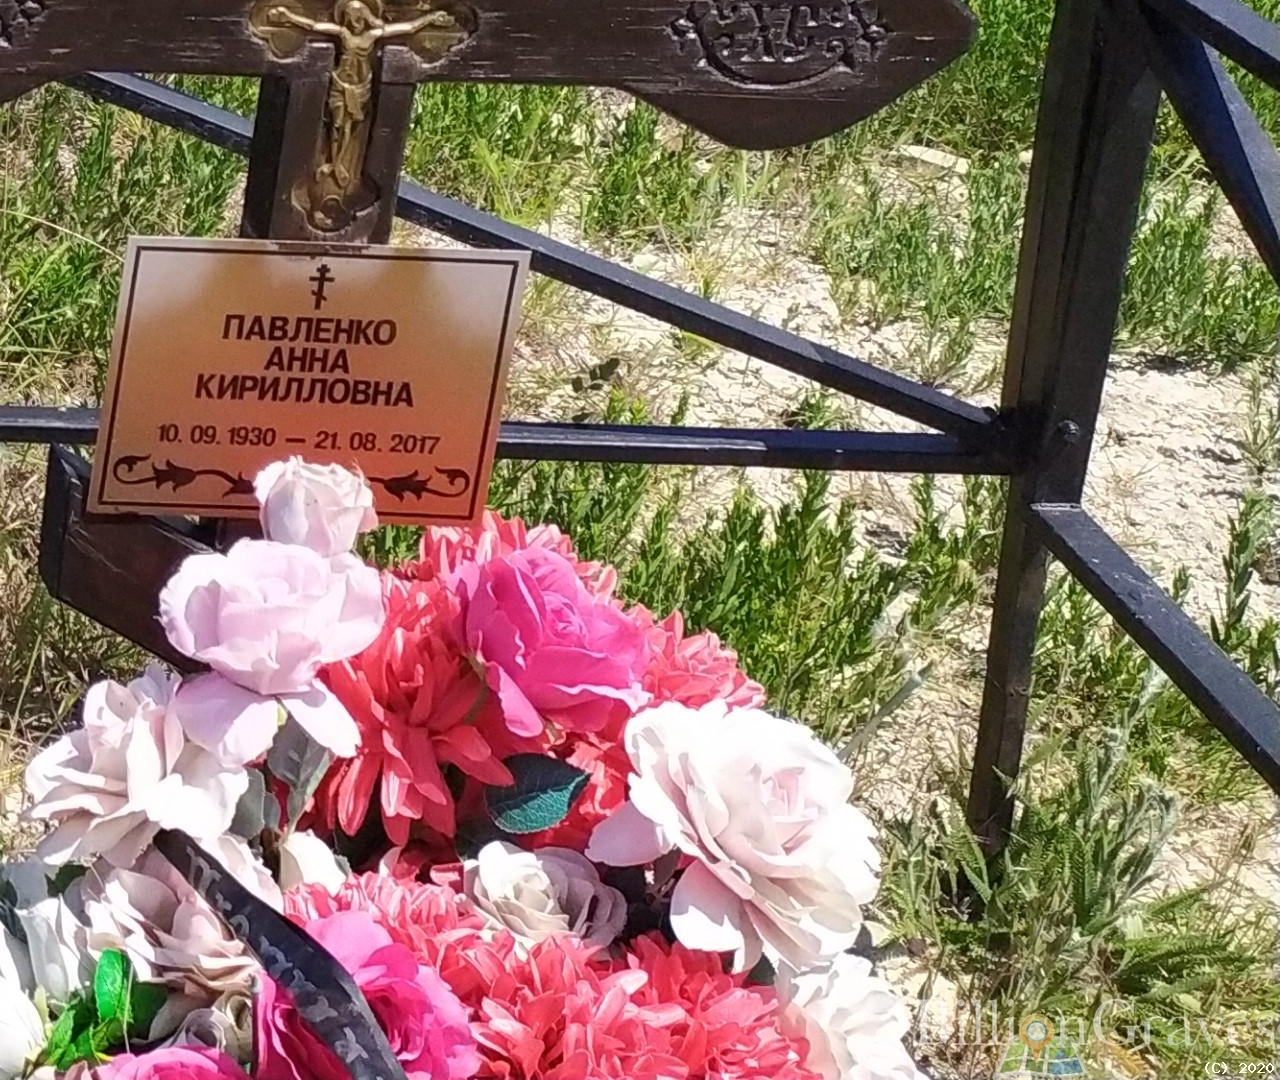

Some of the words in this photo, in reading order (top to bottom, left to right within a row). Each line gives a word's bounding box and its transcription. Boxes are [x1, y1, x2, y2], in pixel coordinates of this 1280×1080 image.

[221, 314, 398, 346] ПАВЛЕНКО
[263, 346, 350, 374] АННА
[194, 373, 415, 408] КИРИЛЛОВНА
